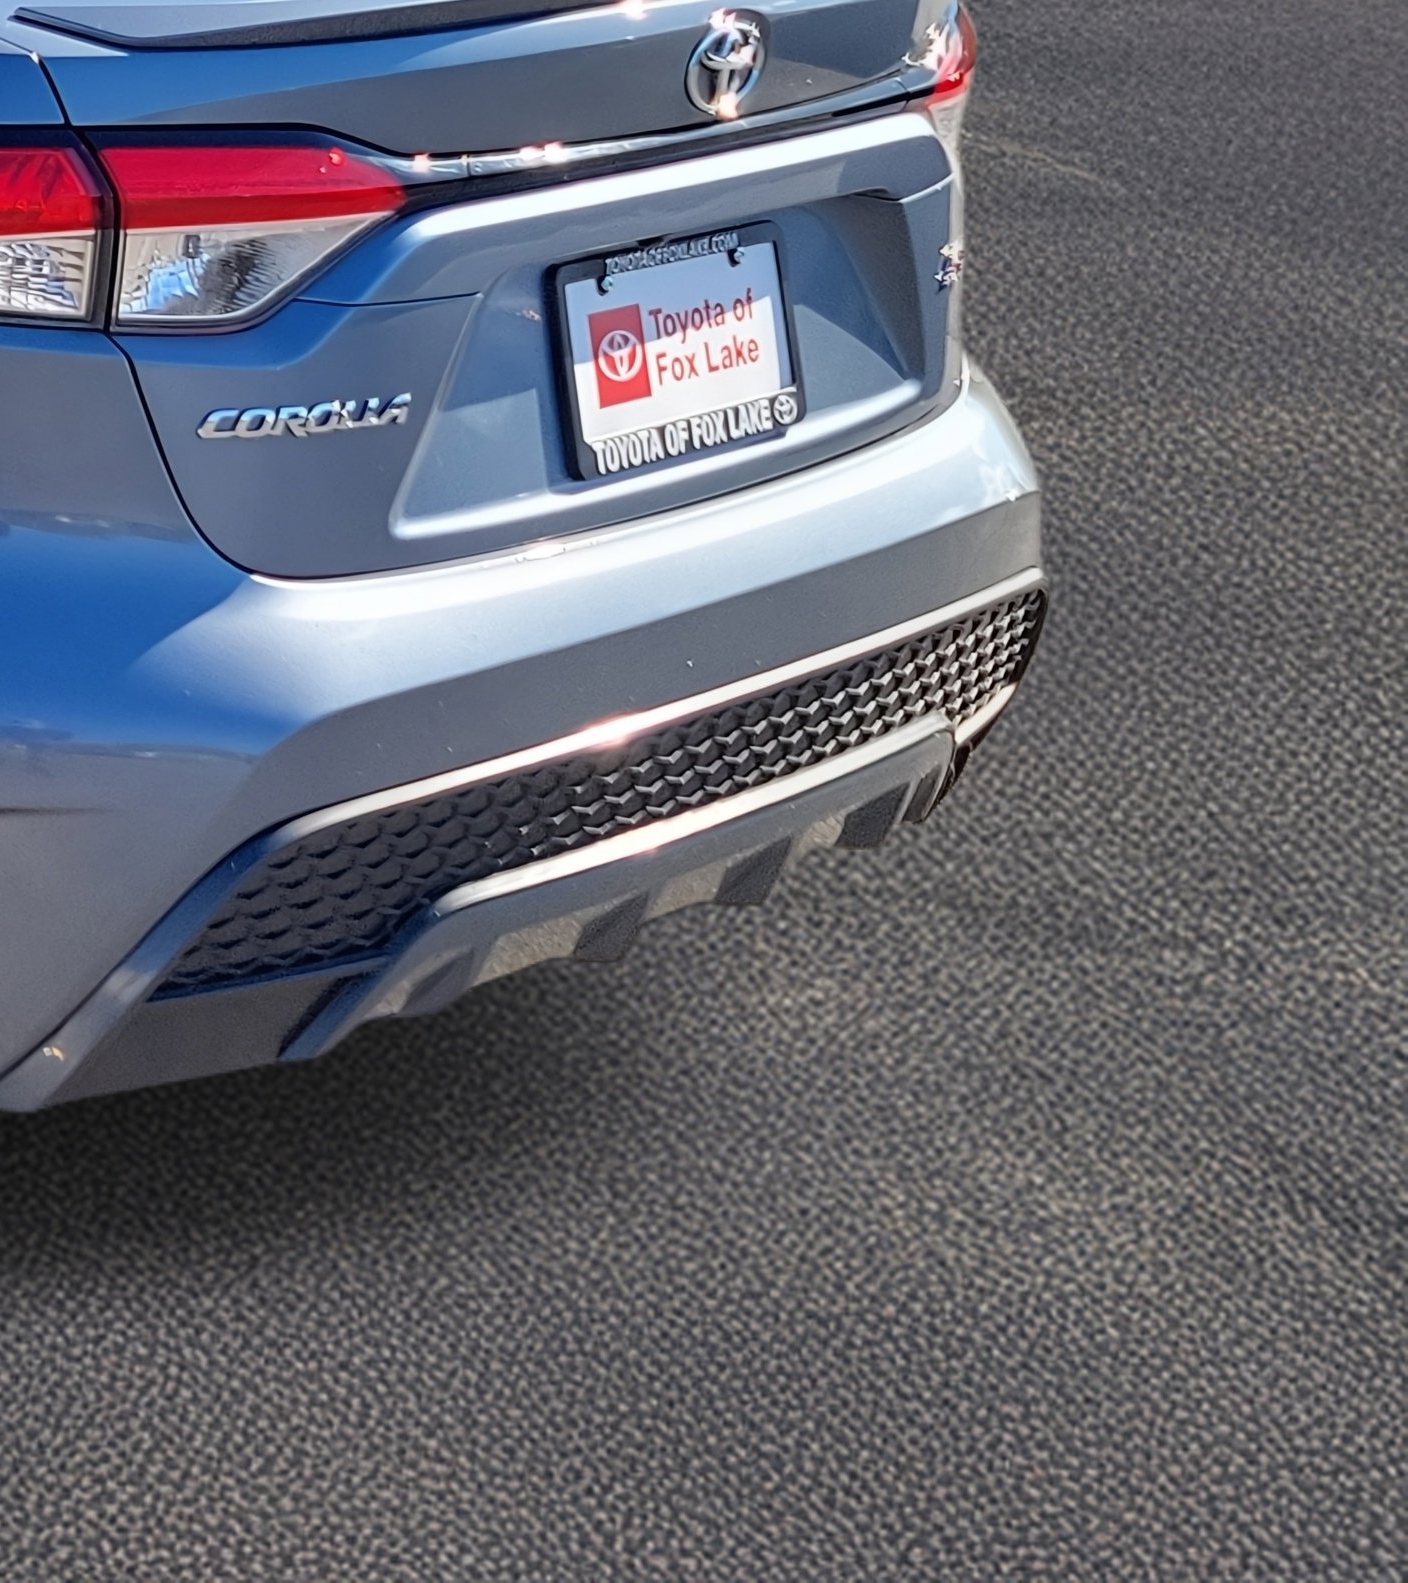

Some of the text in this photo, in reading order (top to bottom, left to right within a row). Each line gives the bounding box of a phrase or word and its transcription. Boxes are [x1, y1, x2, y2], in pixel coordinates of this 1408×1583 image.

[649, 287, 754, 344] Toyota of
[655, 334, 760, 386] Fox Lake
[196, 392, 412, 439] COROLLA
[591, 398, 774, 475] TOYOTA OF FOX LAKE
